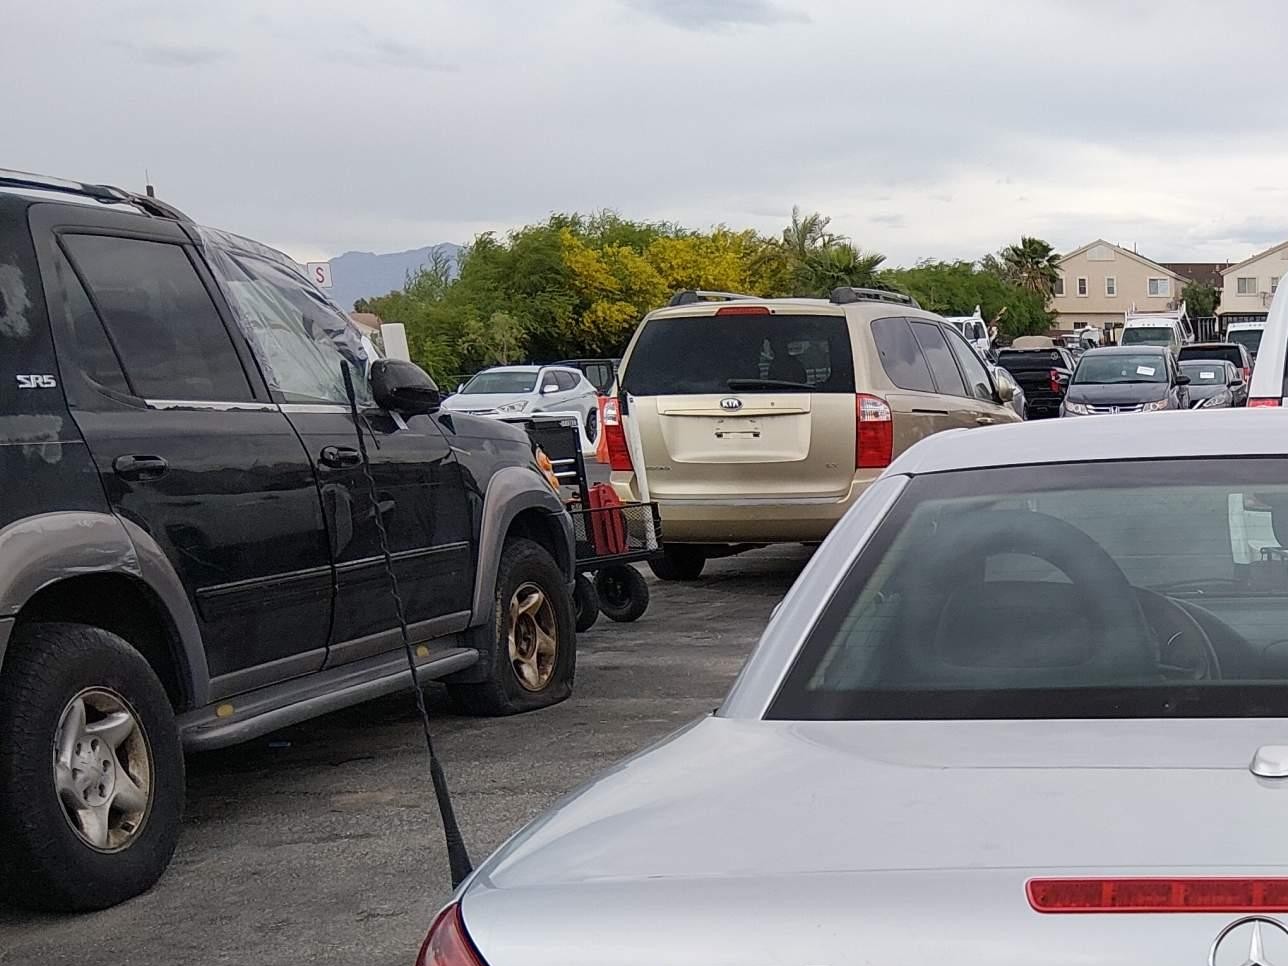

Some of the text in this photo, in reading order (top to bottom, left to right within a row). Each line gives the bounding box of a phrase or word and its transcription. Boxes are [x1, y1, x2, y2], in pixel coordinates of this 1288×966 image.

[315, 266, 326, 284] S
[16, 374, 57, 388] SR5
[721, 399, 740, 409] KIA
